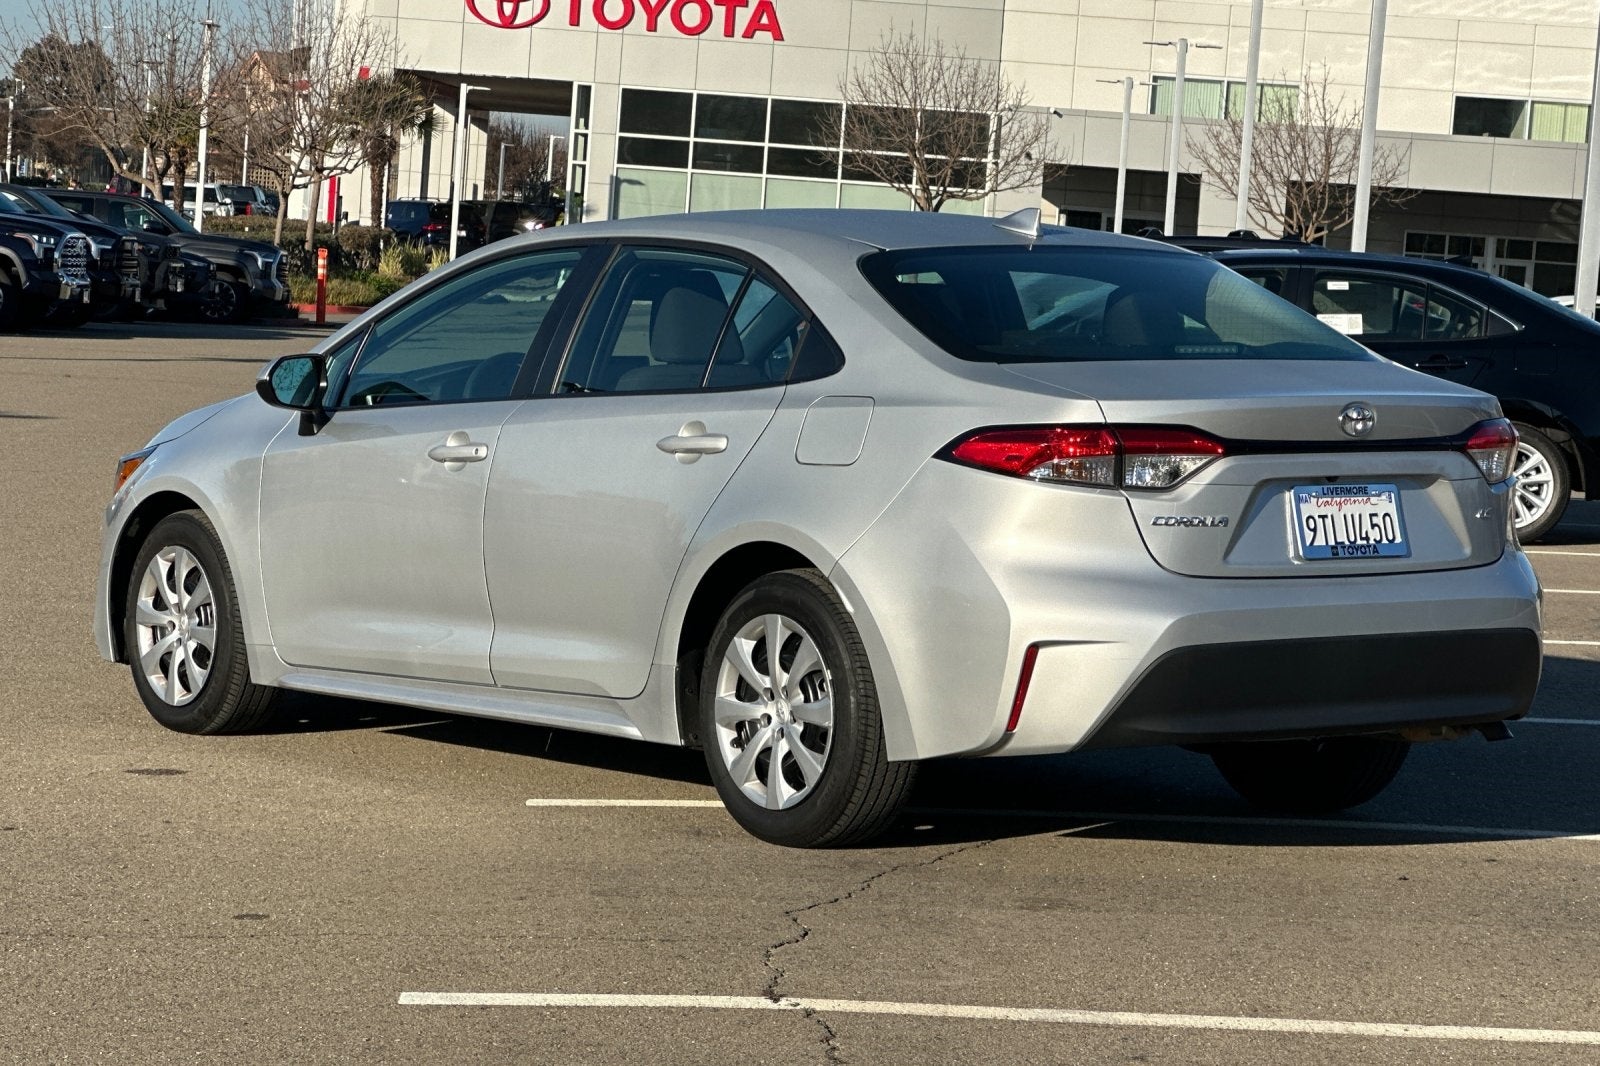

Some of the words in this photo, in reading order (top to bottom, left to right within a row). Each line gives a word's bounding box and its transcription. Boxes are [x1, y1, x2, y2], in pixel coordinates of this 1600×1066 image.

[1322, 486, 1369, 496] LIVERMORE
[1150, 515, 1229, 528] COROLLA
[1305, 512, 1396, 547] 9TLU450
[1341, 545, 1380, 556] TOYOTA
